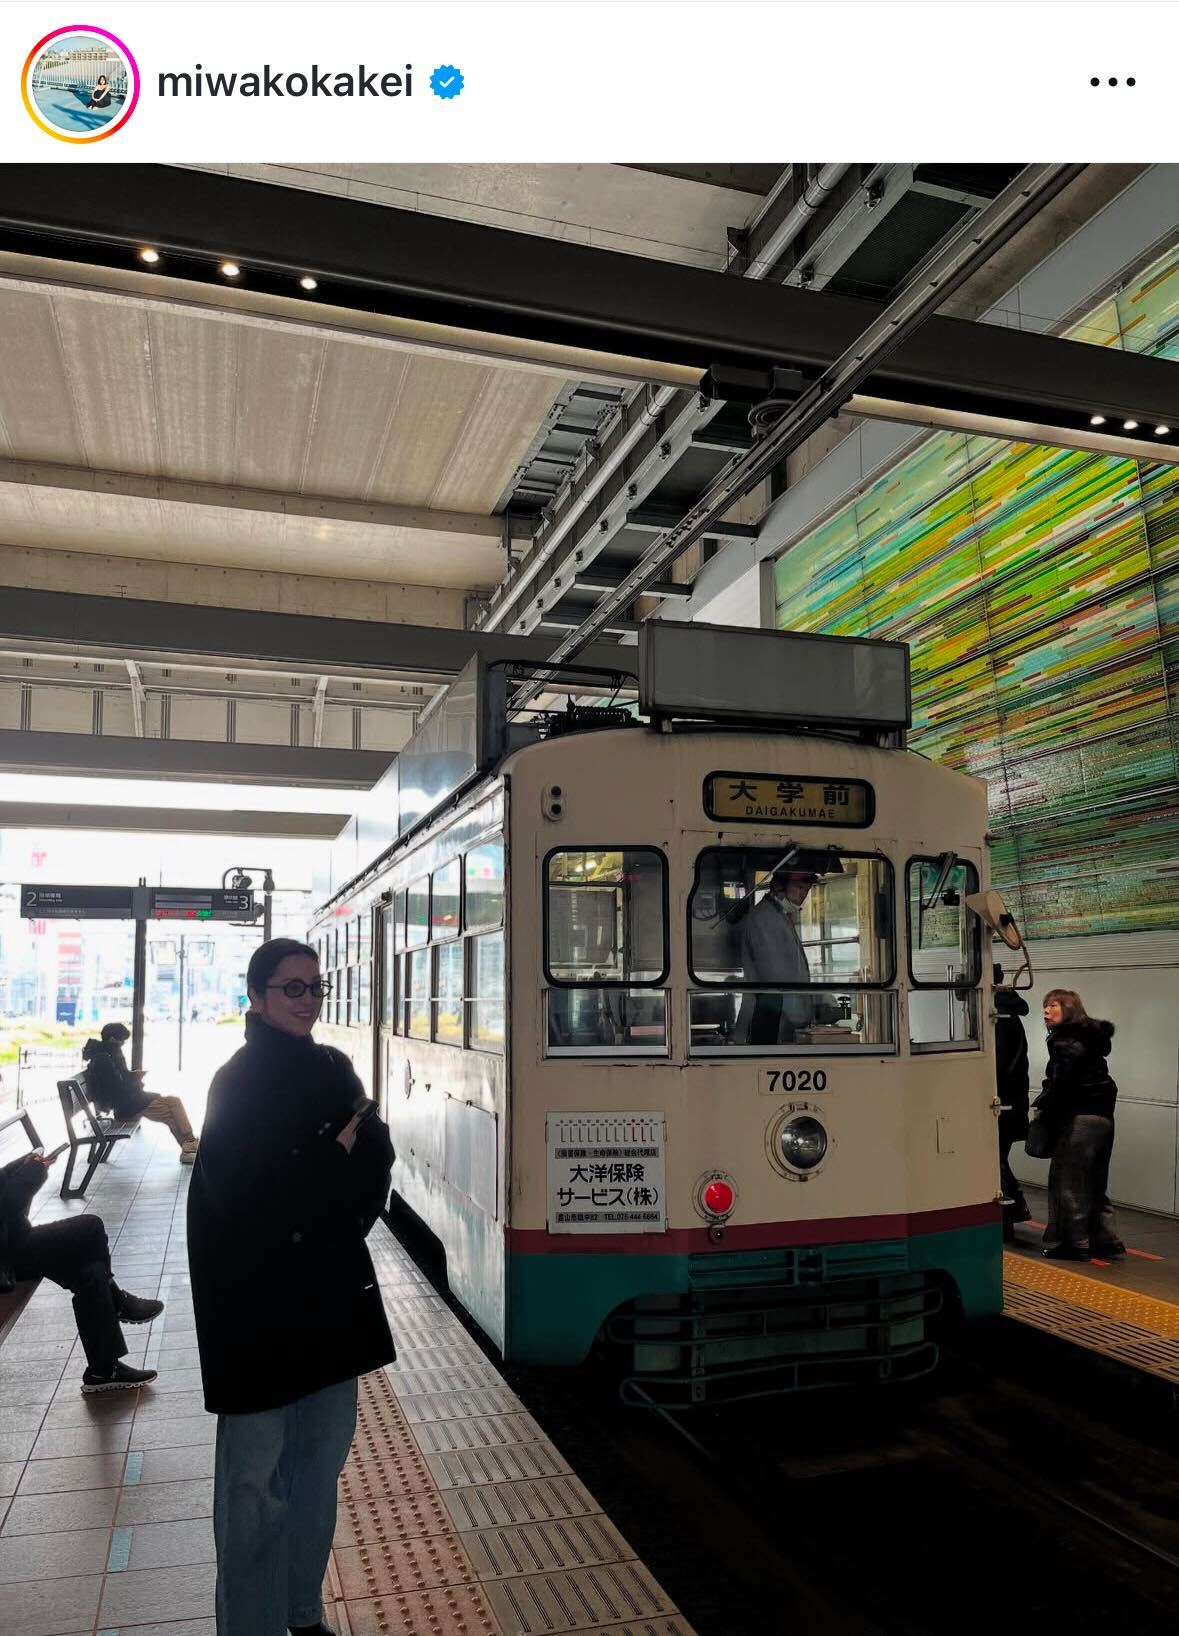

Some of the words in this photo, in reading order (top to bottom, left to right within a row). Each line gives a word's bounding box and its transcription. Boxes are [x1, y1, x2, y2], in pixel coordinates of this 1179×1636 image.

[729, 780, 849, 806] 大学前
[745, 805, 836, 819] DAIGAKUMAE
[26, 891, 37, 907] 2
[239, 895, 249, 910] 3
[766, 1070, 827, 1092] 7020
[569, 1163, 645, 1183] 大洋保険
[557, 1186, 659, 1206] サービス(株)
